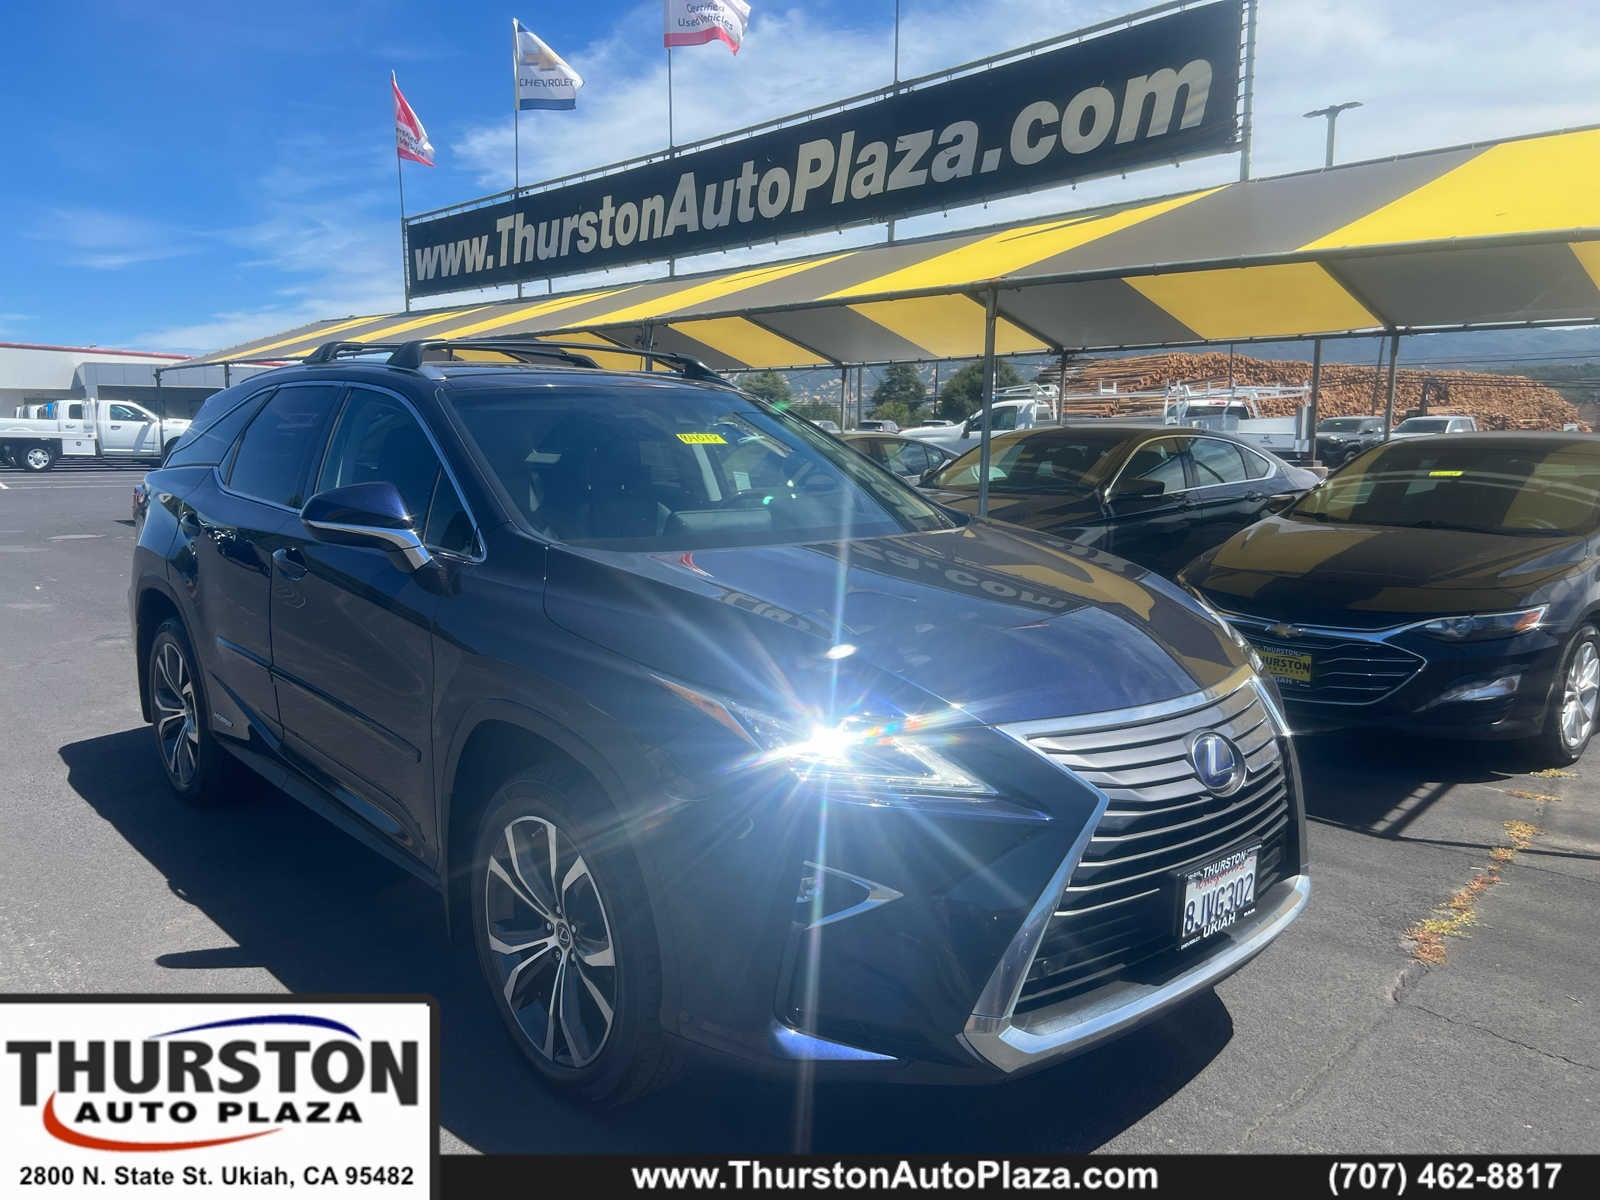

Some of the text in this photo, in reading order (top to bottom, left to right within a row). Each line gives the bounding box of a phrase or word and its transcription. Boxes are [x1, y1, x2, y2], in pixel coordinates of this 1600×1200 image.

[415, 58, 1212, 282] www.ThurstonAutoPlaza.com
[1203, 850, 1246, 879] THURSTON
[1184, 872, 1254, 936] 8JVG302
[1203, 911, 1236, 938] UKIAH
